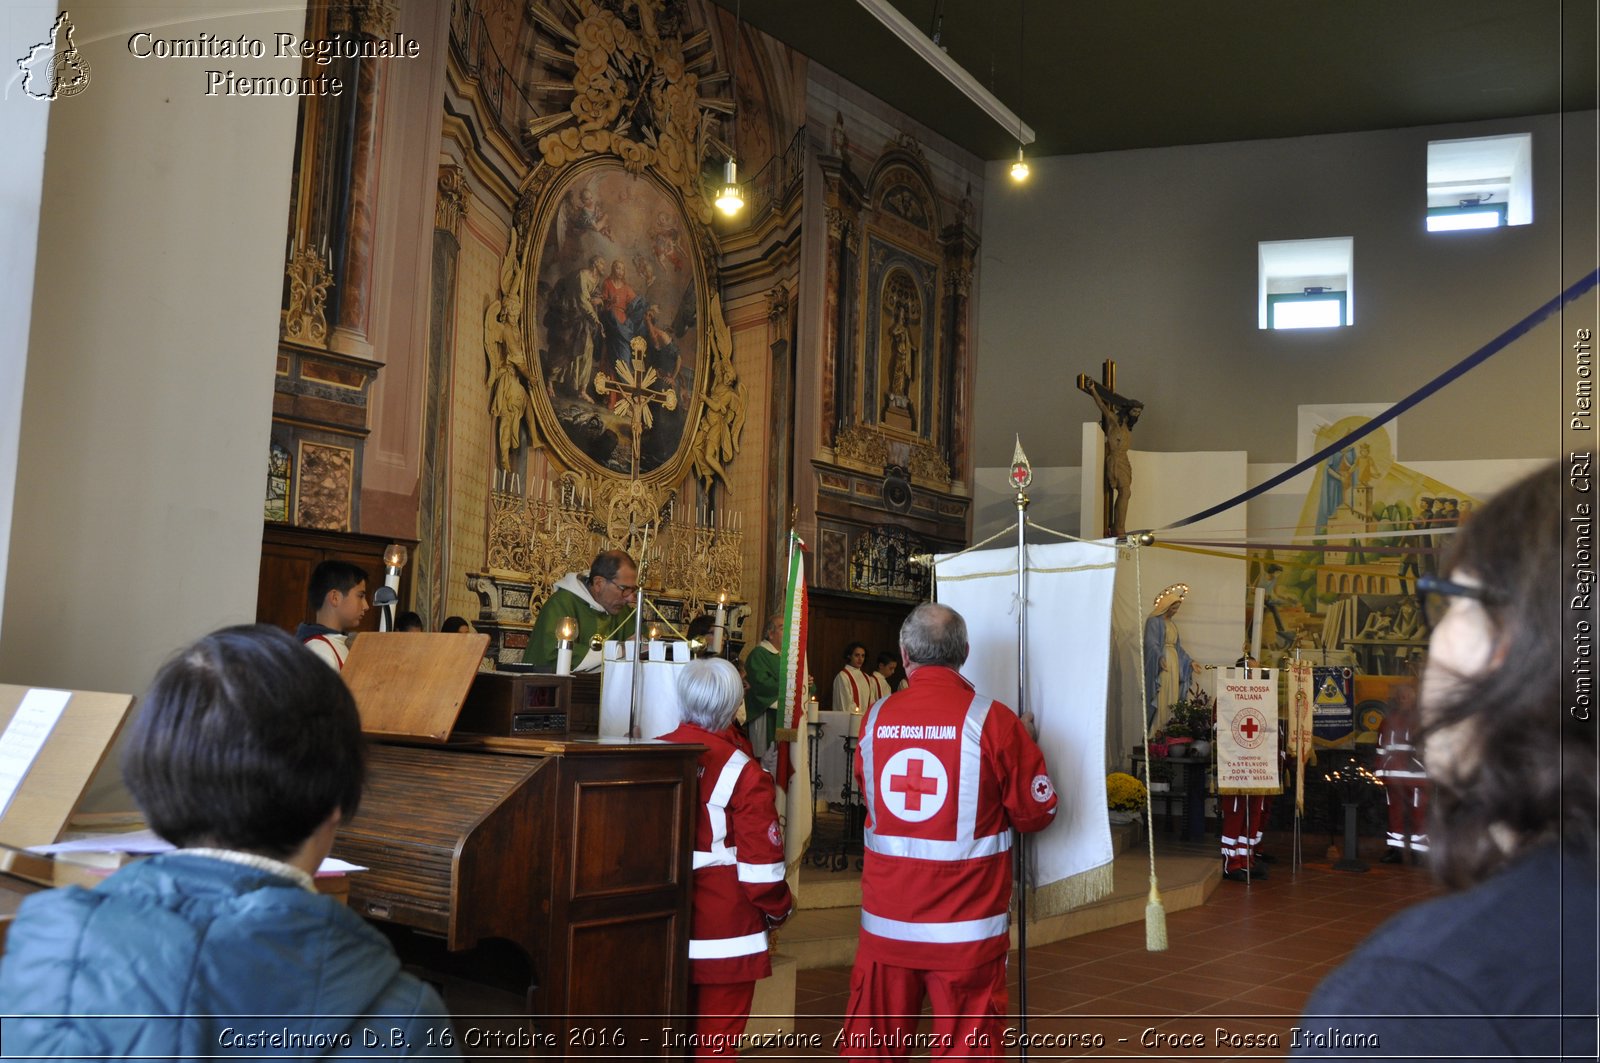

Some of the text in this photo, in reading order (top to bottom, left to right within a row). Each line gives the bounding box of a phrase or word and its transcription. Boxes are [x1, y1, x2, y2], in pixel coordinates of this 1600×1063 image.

[1226, 685, 1270, 693] CROCE ROSSA
[1234, 693, 1263, 701] ITALIANA
[877, 725, 957, 740] CROCE ROSSA ITALIANA
